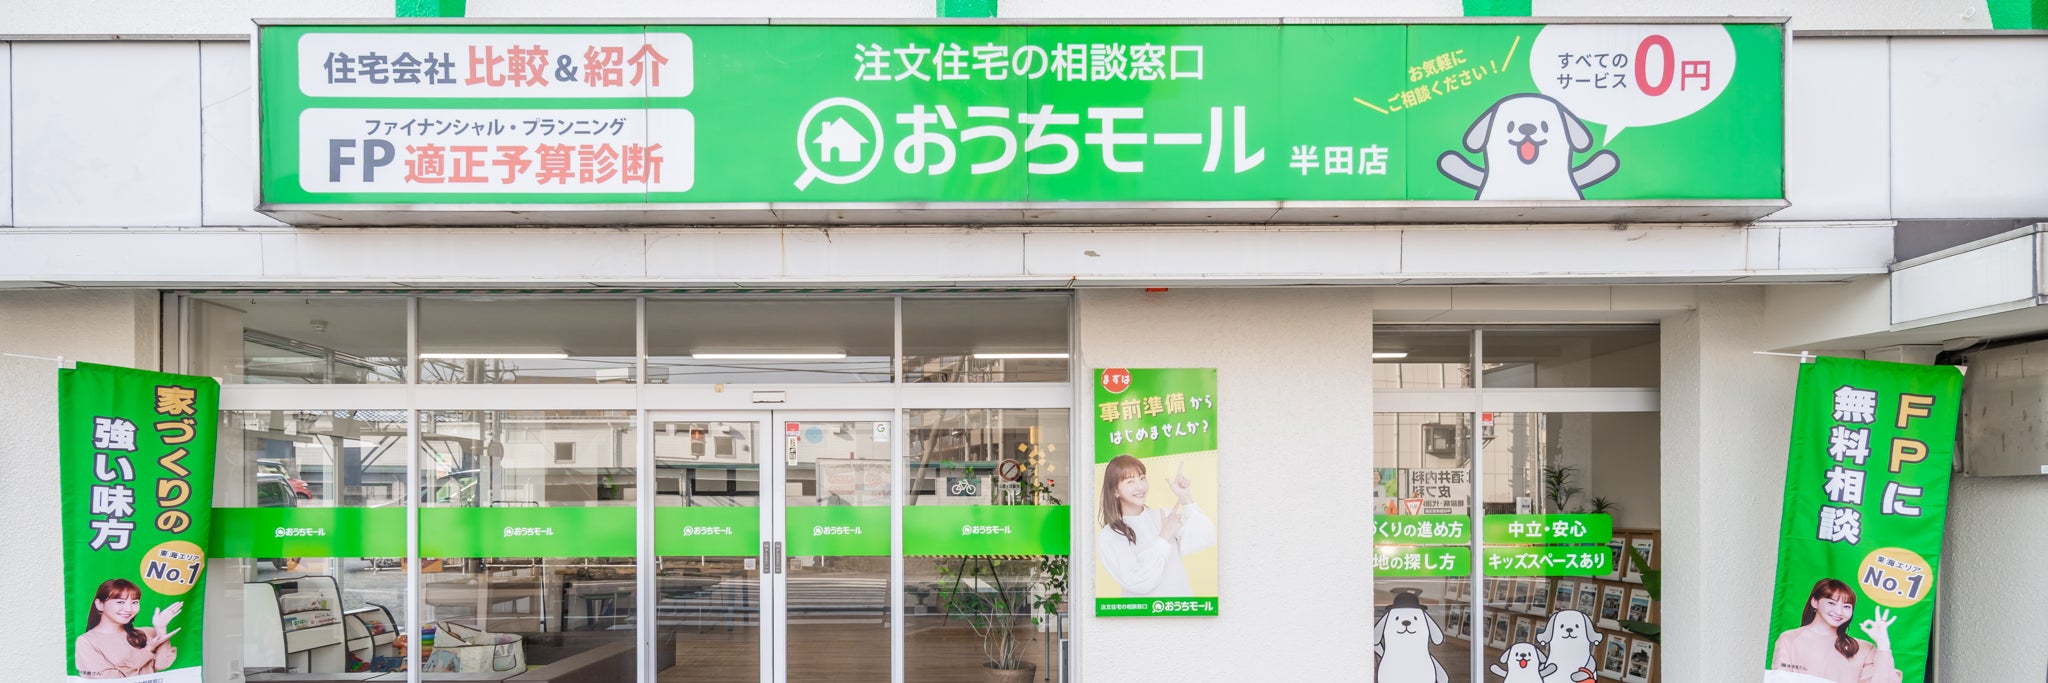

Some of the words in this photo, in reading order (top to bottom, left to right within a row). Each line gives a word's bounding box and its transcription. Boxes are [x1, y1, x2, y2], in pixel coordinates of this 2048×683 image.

[323, 51, 457, 86] 住宅会社
[854, 43, 1204, 81] 注文住宅の相談窓口
[1408, 49, 1467, 83] お気軽に
[1557, 52, 1628, 69] すべての
[1387, 60, 1498, 112] ご相談ください！
[1556, 73, 1628, 90] サービス
[364, 117, 627, 137] ファイナンシャル・プランニング
[893, 104, 1265, 176] おうちモール
[328, 138, 396, 183] FP
[404, 142, 664, 185] 適正予算診断
[1289, 145, 1389, 176] 半田店
[1102, 374, 1131, 385] まずは
[154, 384, 198, 534] 家づくりの
[1816, 385, 1878, 546] 無料相談
[88, 415, 137, 552] 強い味方
[1508, 520, 1587, 537] 中立・安心
[145, 560, 201, 586] No.1
[1489, 552, 1605, 570] キッズスペースあり
[1862, 565, 1925, 600] No.1
[1165, 601, 1214, 612] おうちモール
